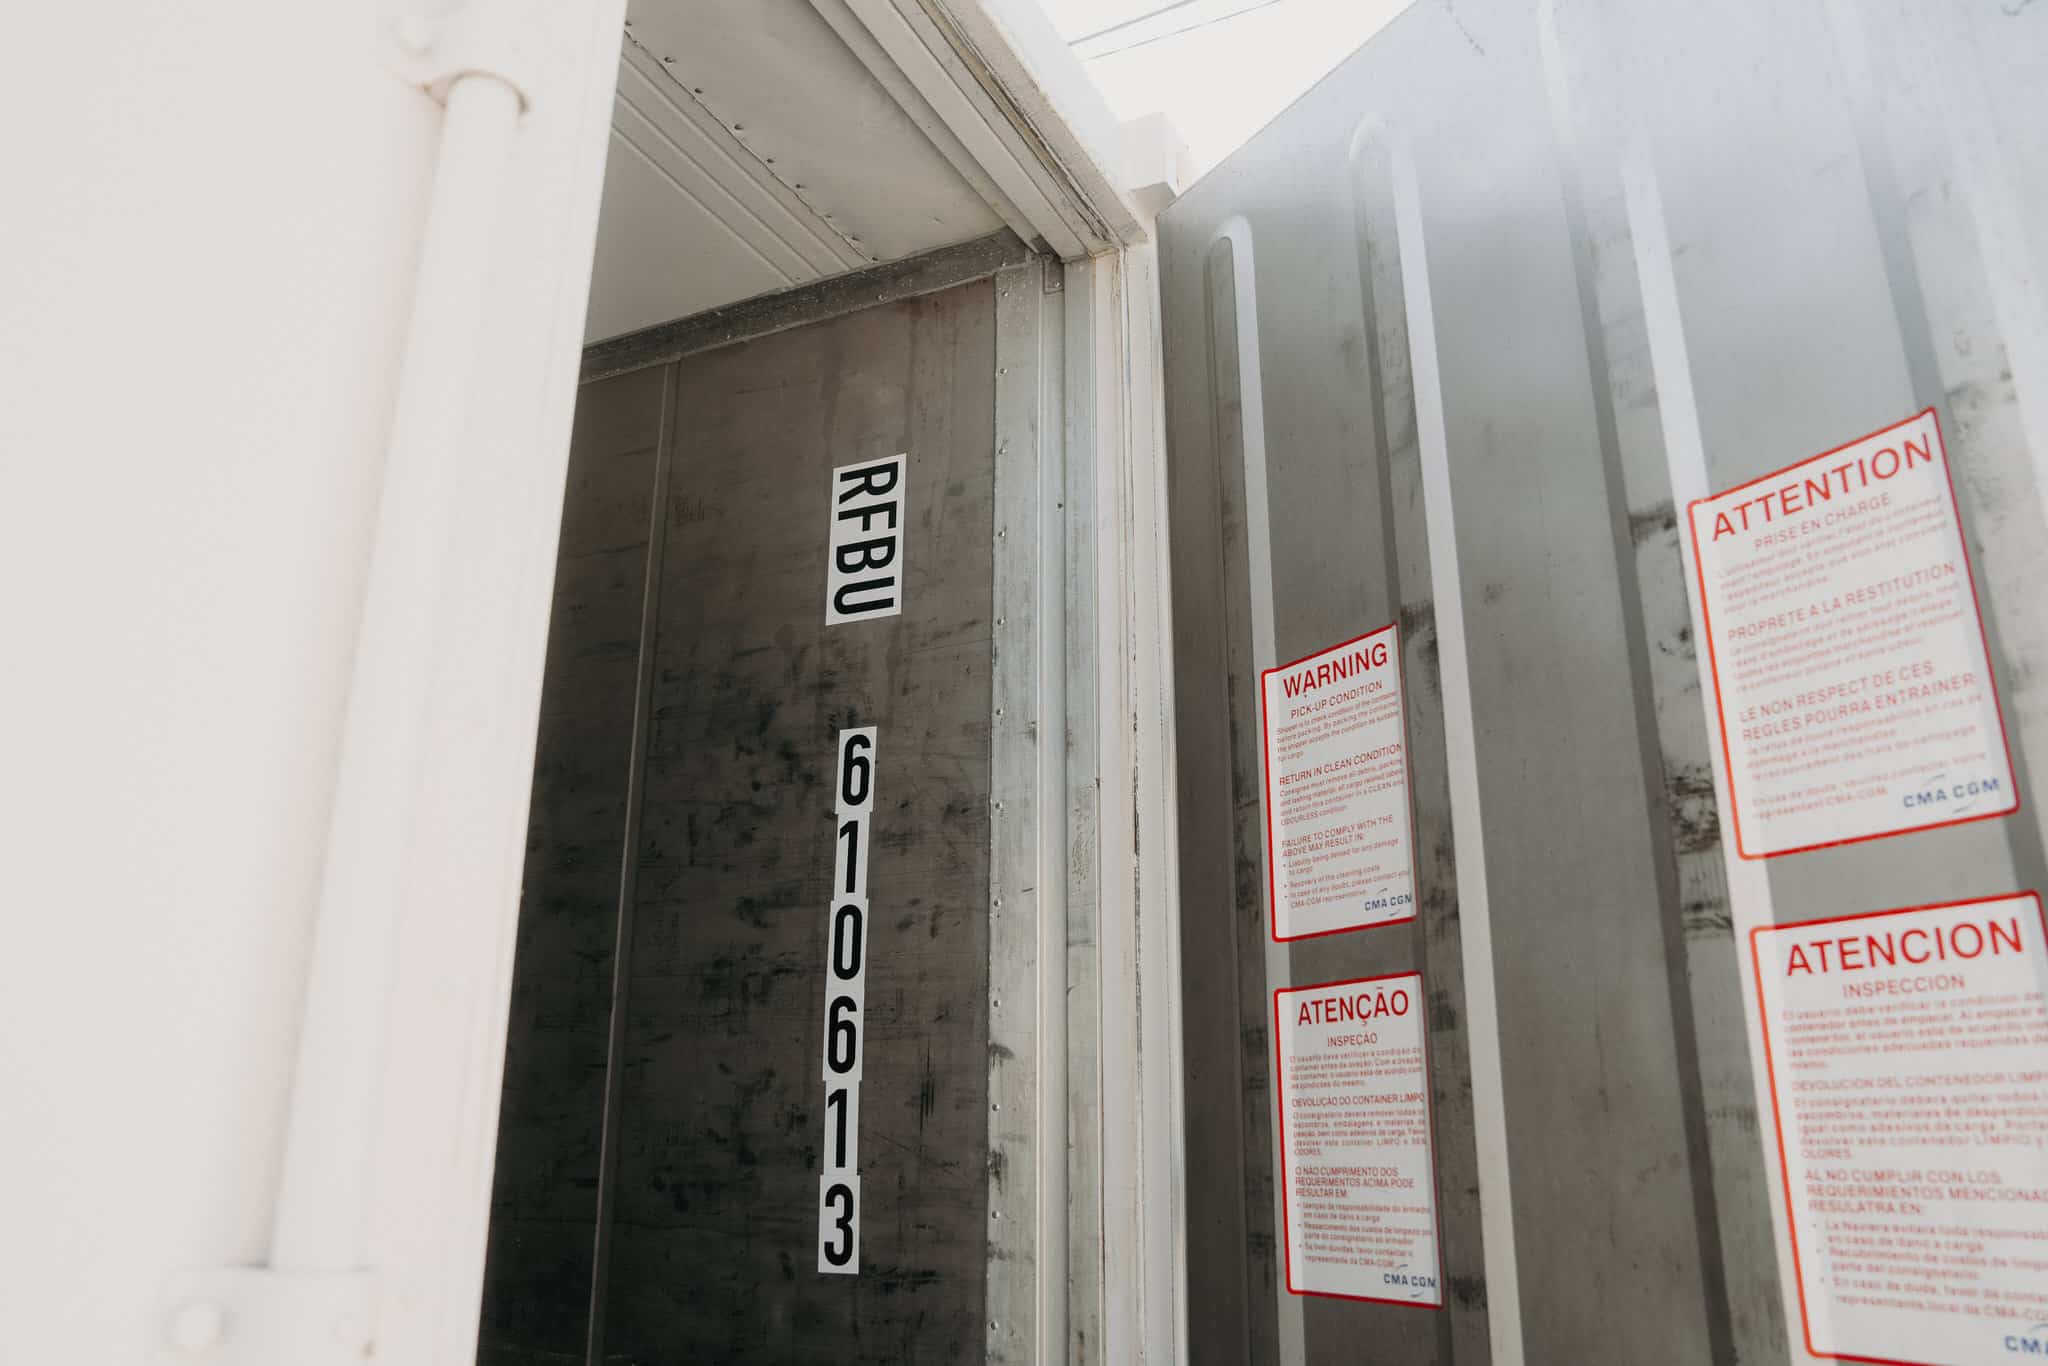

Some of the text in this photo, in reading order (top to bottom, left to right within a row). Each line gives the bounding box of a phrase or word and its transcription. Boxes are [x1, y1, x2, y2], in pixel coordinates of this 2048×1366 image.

[1713, 433, 1932, 541] ATTENTION
[1755, 492, 1889, 551] PRISE EN CHARGE
[834, 461, 899, 615] RFBU
[1822, 597, 1841, 614] LA
[1845, 560, 1956, 606] RESTITUTION
[1283, 643, 1387, 698] WARNING
[1291, 680, 1382, 719] PICK-UP CONDITION
[1740, 660, 1933, 723] LE NON RESPECT DE CES
[1743, 716, 1801, 741] REGLES
[1805, 699, 1871, 726] POURRA
[1875, 673, 1976, 710] ENTRAINER
[1279, 769, 1312, 786] RETURN
[1314, 767, 1322, 776] IN
[1324, 758, 1352, 774] CLEAN
[1353, 743, 1401, 765] CONDITION
[1903, 778, 2000, 808] CMA CGM
[1282, 814, 1393, 847] FAILURE TO COMPLY WITH THE
[1282, 845, 1307, 857] ABOVE
[1308, 842, 1323, 852] MAY
[1324, 835, 1353, 848] RESULT
[1365, 898, 1387, 911] CMA
[1787, 918, 2022, 976] ATENCION
[1842, 974, 1965, 998] INSPECCION
[1298, 987, 1409, 1026] ATENÇÃO
[1339, 1096, 1351, 1106] DO
[1352, 1094, 1398, 1105] CONTAINER
[1400, 1089, 1424, 1103] LIMPO
[1295, 1166, 1302, 1177] O
[1320, 1166, 1378, 1177] CUMPRIMENTO
[1380, 1167, 1399, 1177] DOS
[1362, 1178, 1389, 1188] ACIMA
[1390, 1178, 1414, 1188] PODE
[1805, 1169, 1822, 1184] AL
[1826, 1170, 1847, 1181] NO
[1851, 1169, 1922, 1184] CUMPLIR
[1926, 1170, 1964, 1184] CON
[1296, 1188, 1334, 1197] RESULTAR
[1807, 1183, 1944, 1200] REQUERIMIENTOS
[1809, 1200, 1896, 1214] RESULATRA
[1384, 1273, 1408, 1285] CMA
[2004, 1336, 2048, 1354] CM
